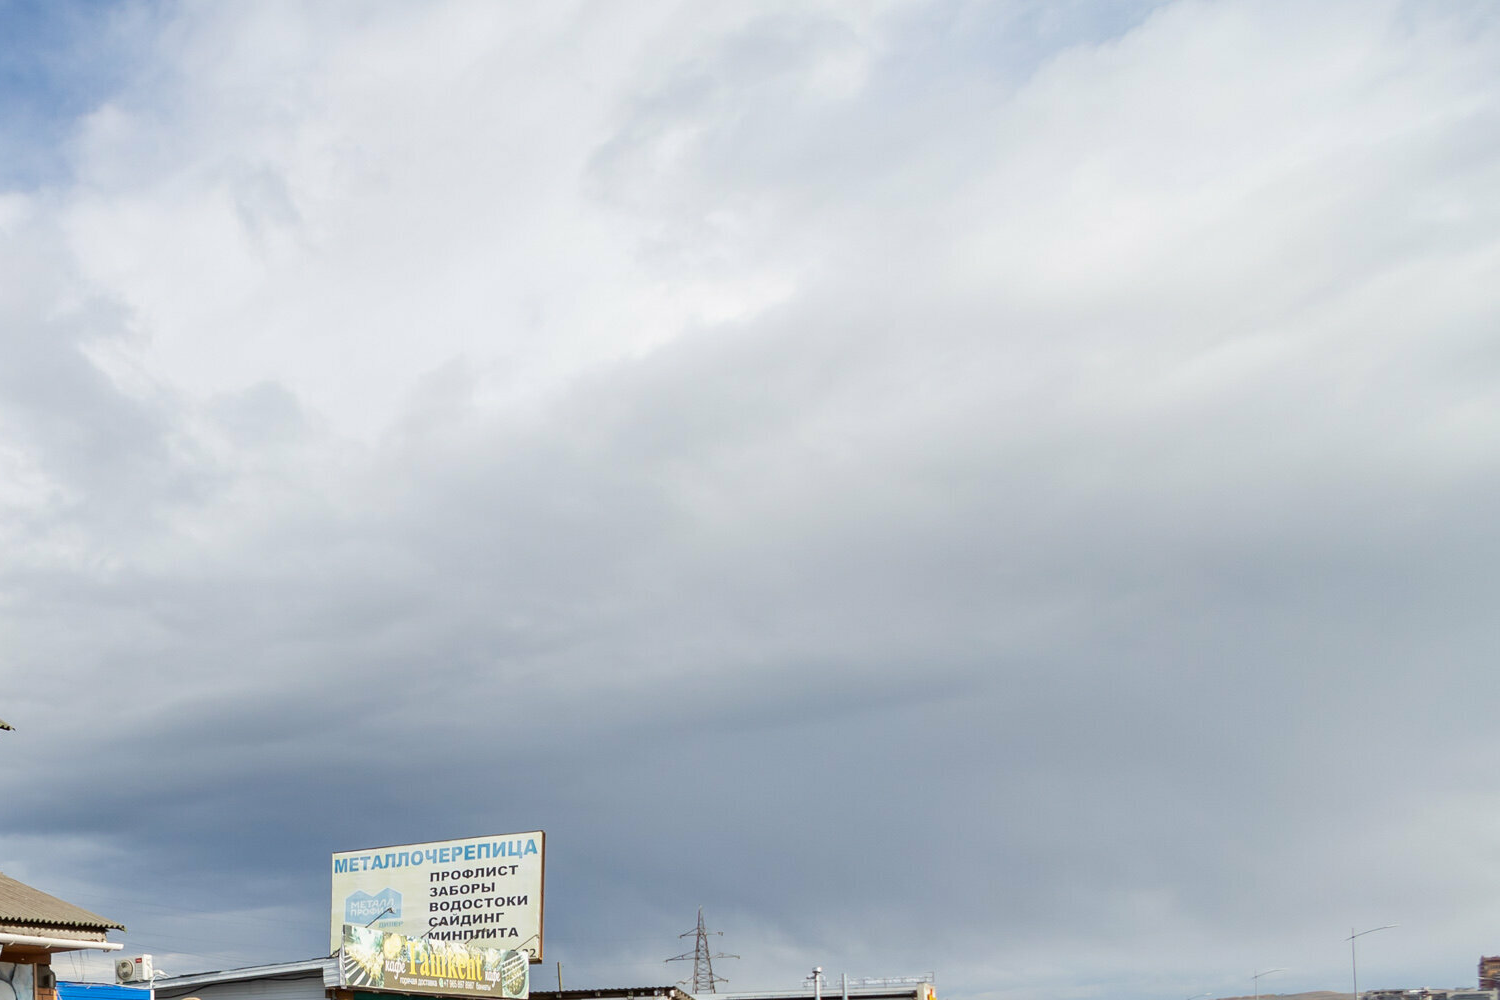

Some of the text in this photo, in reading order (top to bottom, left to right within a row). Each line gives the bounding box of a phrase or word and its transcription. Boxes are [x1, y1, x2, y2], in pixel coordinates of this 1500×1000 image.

[334, 838, 538, 874] МЕТАЛЛОЧЕРЕПИЦА
[429, 865, 519, 883] ПРОФЛИСТ
[429, 882, 496, 898] ЗАБОРЫ
[351, 898, 395, 910] МЕТАЛЛ
[429, 895, 528, 913] ВОДОСТОКИ
[428, 911, 505, 928] САЙДИНГ
[428, 926, 519, 942] МИНПЛИТА
[385, 959, 406, 980] кафе
